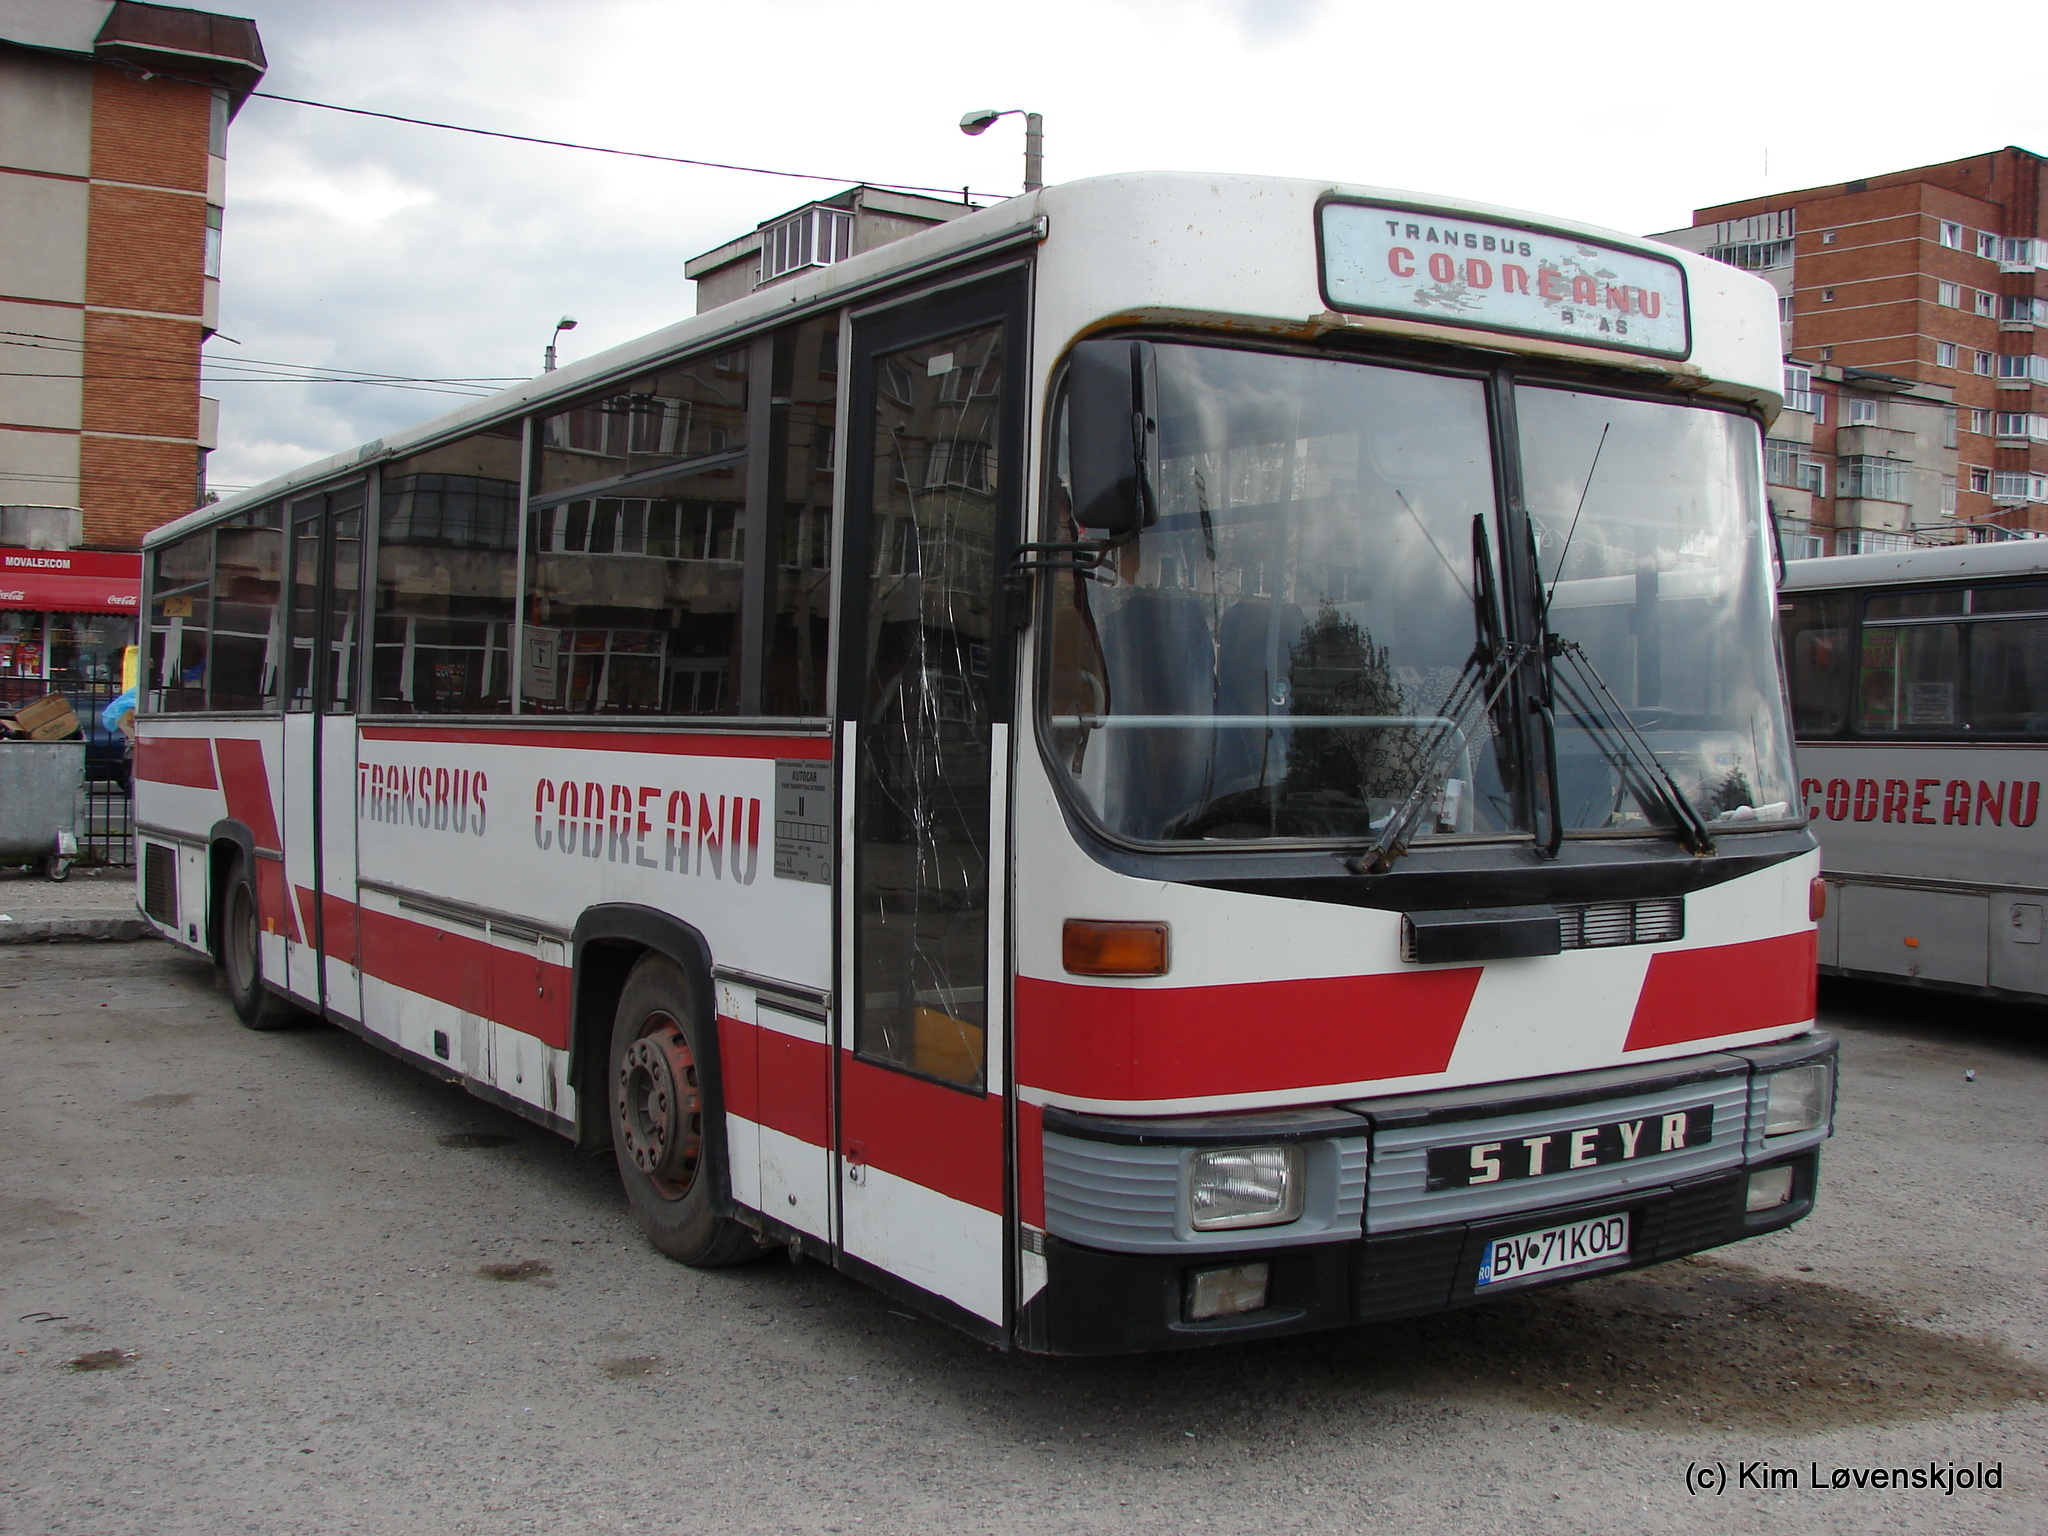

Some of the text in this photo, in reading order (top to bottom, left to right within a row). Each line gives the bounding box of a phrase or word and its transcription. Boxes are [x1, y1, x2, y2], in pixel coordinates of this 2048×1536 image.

[1385, 220, 1532, 257] TRANSBUS
[1388, 246, 1661, 319] CODREANU
[5, 556, 71, 569] MOVALEXCOM
[359, 762, 488, 837] TRANSBUS
[792, 771, 818, 783] AUTOCAR
[1800, 777, 2041, 828] CODREANU
[535, 777, 761, 886] CODREANU
[1468, 1111, 1687, 1185] STEYR
[1478, 1265, 1490, 1280] RO
